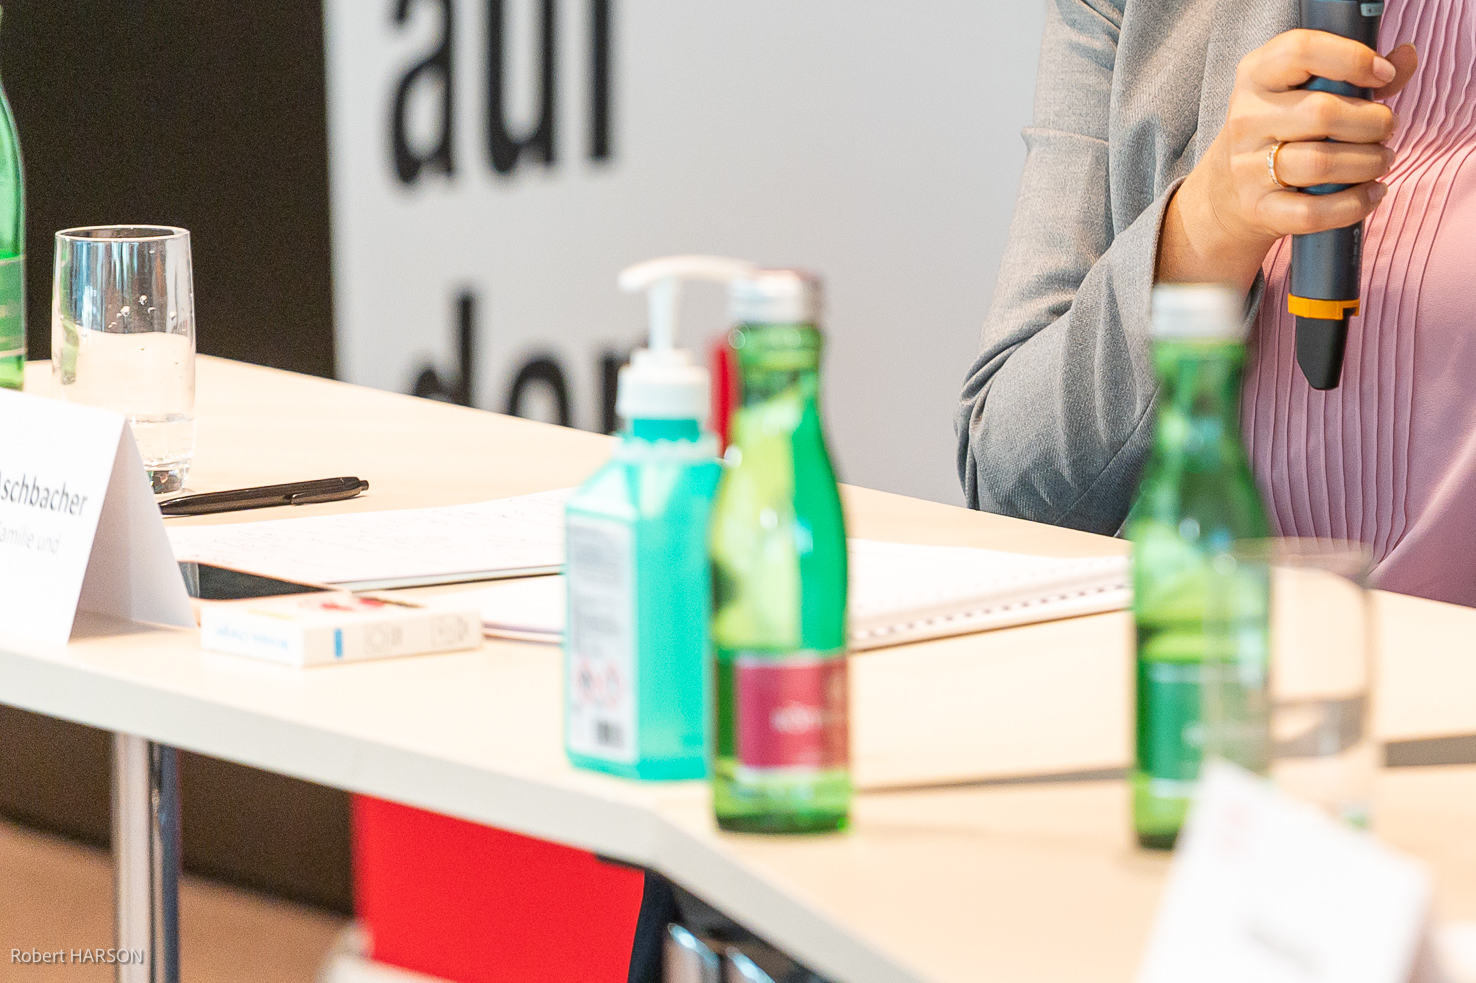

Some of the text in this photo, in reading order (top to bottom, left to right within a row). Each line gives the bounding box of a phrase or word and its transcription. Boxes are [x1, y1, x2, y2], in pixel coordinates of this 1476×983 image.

[0, 470, 88, 516] schbacher
[0, 521, 62, 555] amilie und
